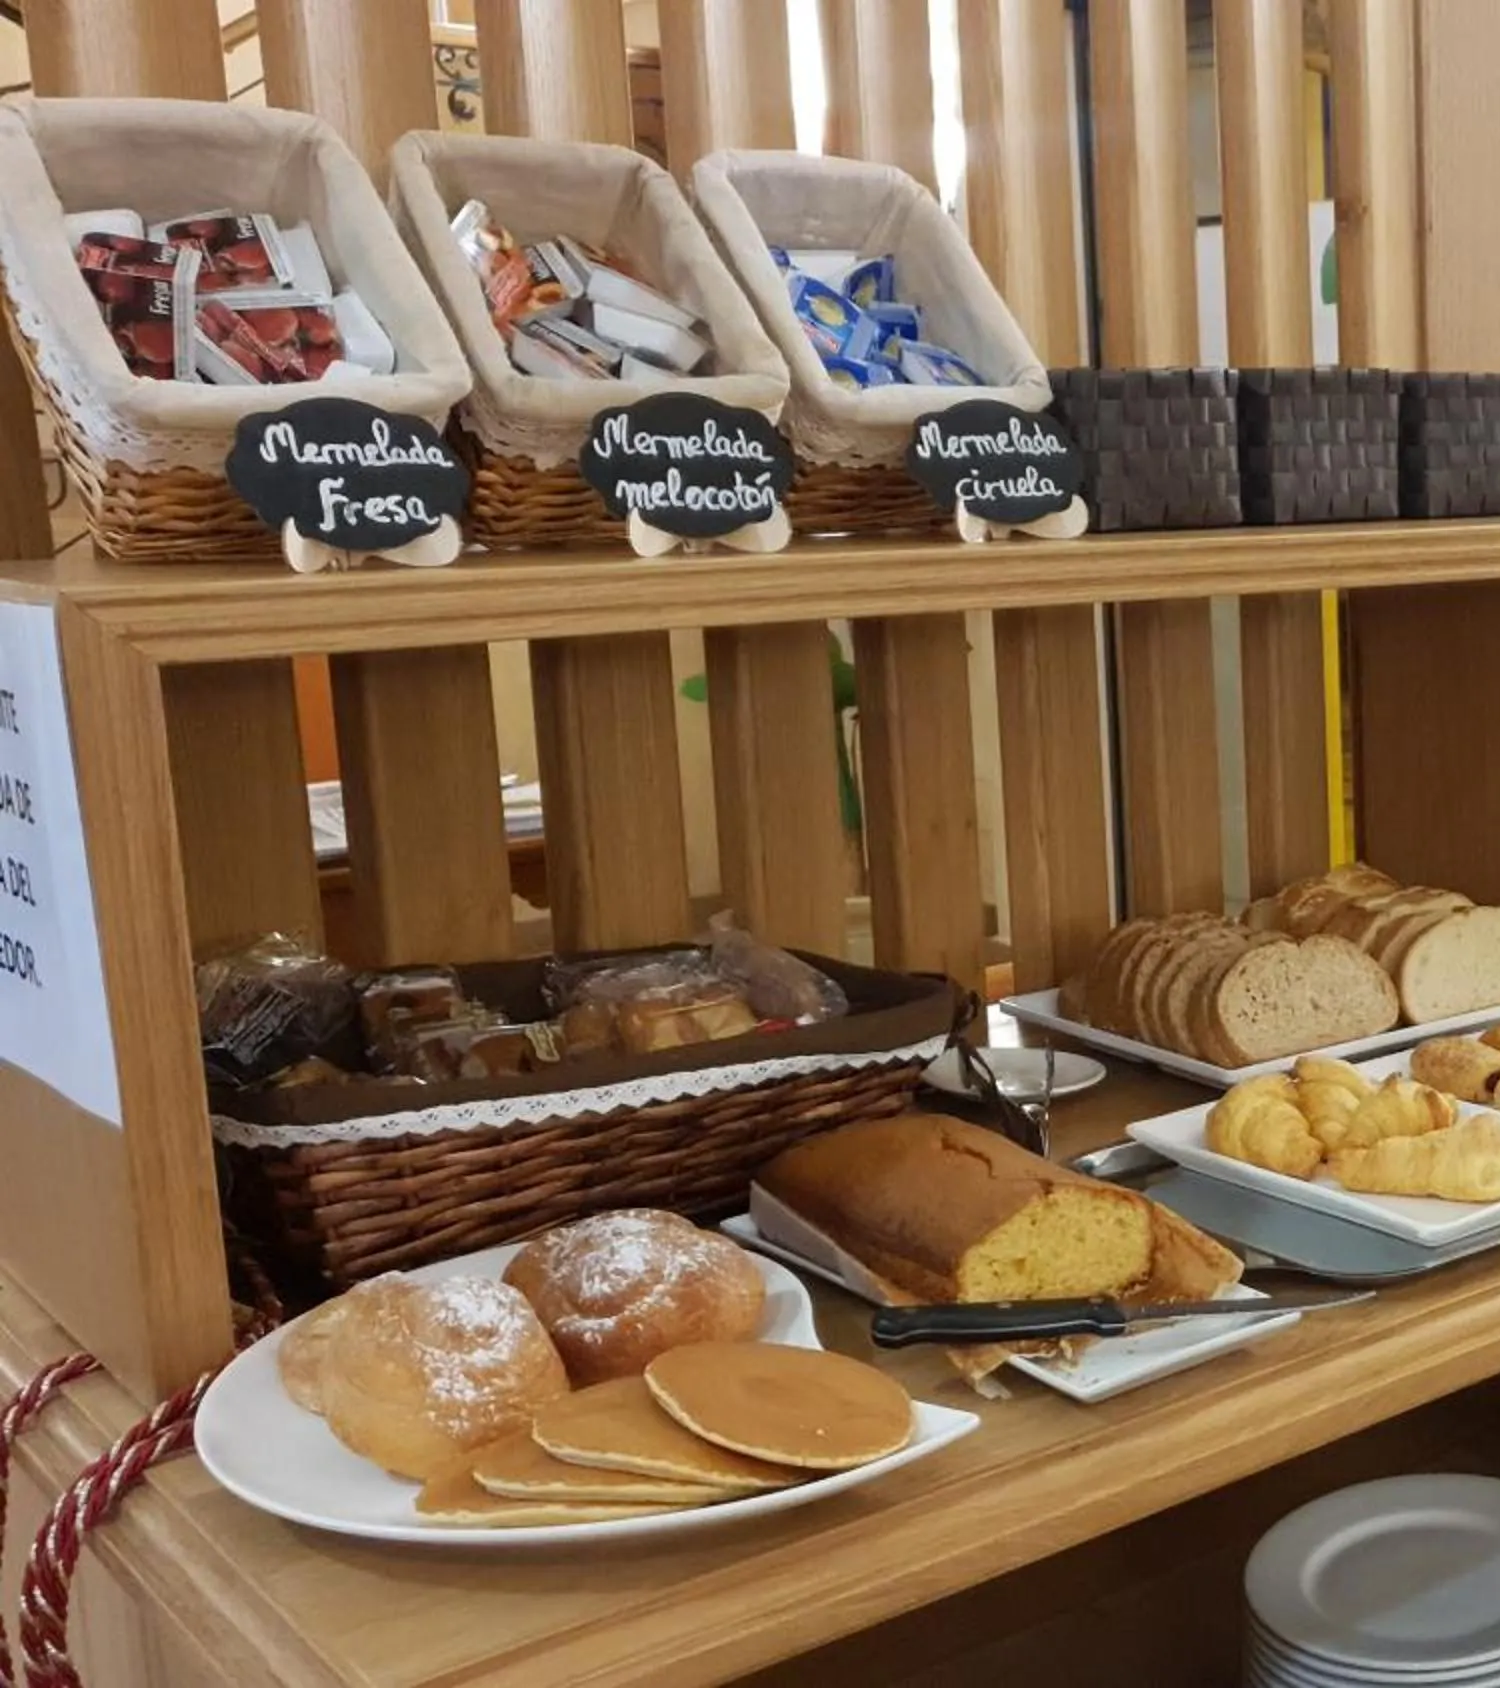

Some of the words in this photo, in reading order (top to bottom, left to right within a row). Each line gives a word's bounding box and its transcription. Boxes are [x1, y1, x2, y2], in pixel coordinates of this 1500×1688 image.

[259, 418, 454, 467] Mermelada
[593, 413, 774, 462] Mermelada
[916, 417, 1067, 459] Mermelada
[319, 479, 443, 531] Fresa
[616, 467, 782, 512] melocotón
[15, 778, 35, 825] DE
[8, 857, 36, 906] DEL
